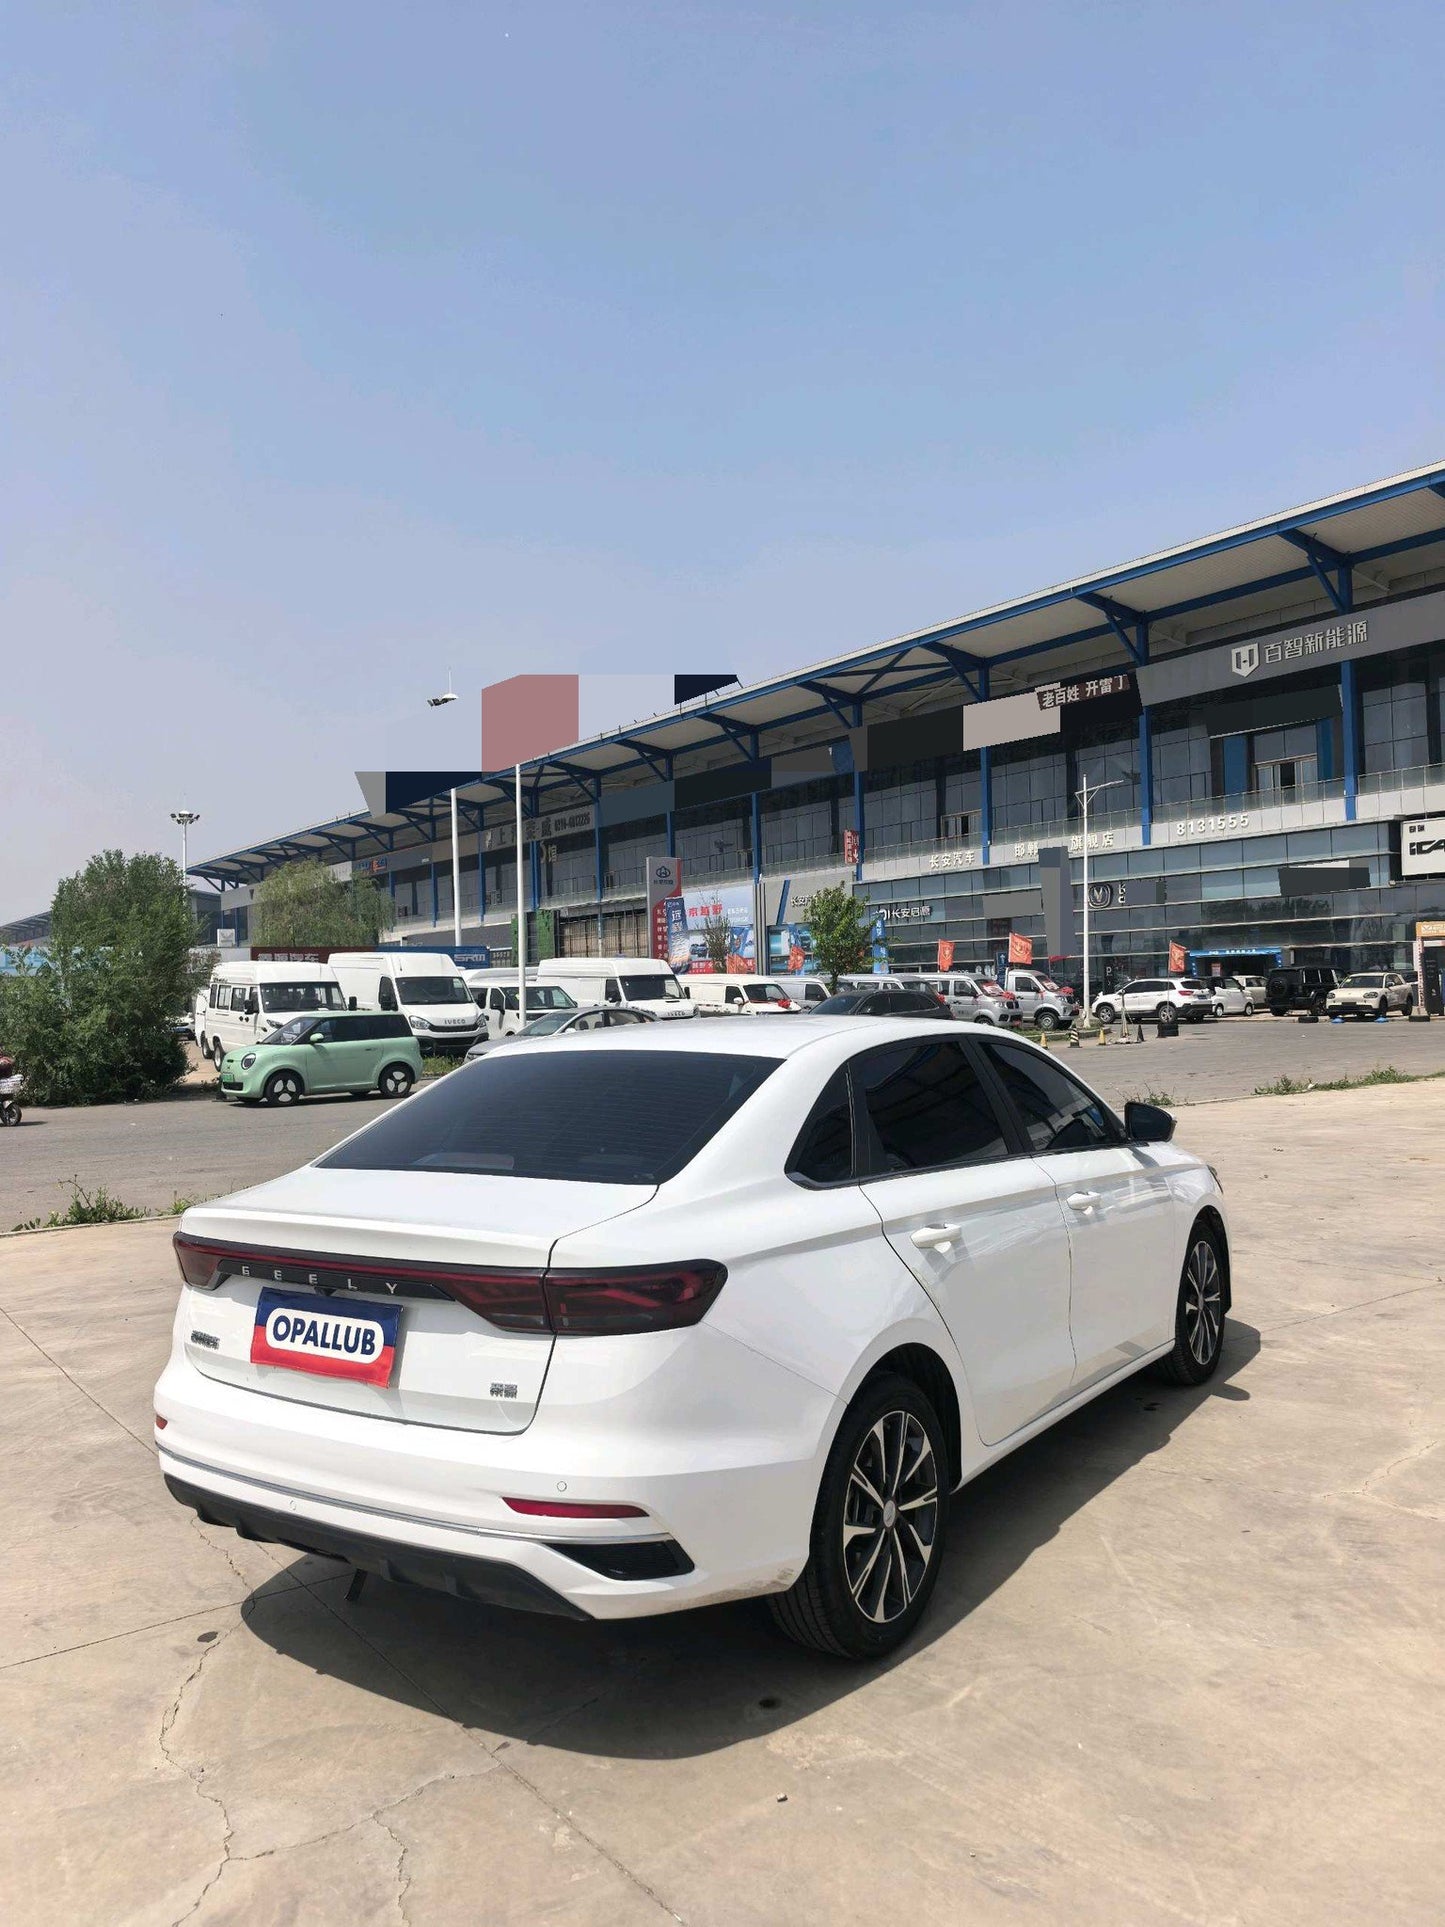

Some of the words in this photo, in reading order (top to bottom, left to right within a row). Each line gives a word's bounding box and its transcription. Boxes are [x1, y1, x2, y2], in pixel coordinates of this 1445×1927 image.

[1264, 620, 1368, 664] 百智新能源
[1042, 686, 1080, 708] 老百姓
[1085, 674, 1128, 697] 开雷丁
[1176, 813, 1250, 836] 8131555
[928, 850, 976, 869] 长安汽车
[241, 1265, 398, 1294] GEELY
[272, 1314, 376, 1356] OPALLUB
